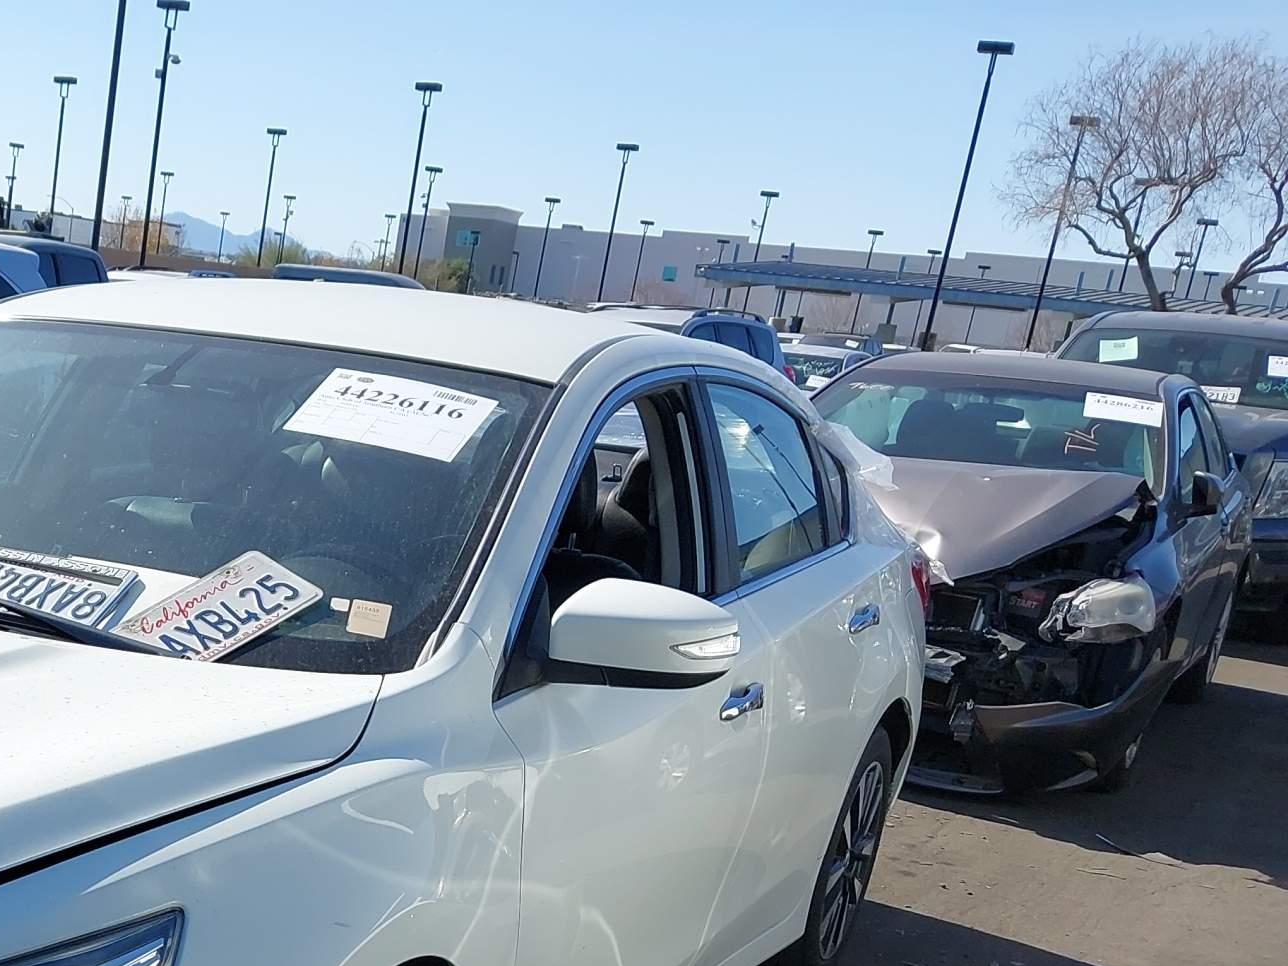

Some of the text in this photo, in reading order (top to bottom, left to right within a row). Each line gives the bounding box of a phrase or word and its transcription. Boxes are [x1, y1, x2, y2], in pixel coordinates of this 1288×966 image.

[334, 385, 467, 419] 44226116
[140, 577, 241, 636] California
[198, 607, 283, 662] dmv.ca.gov
